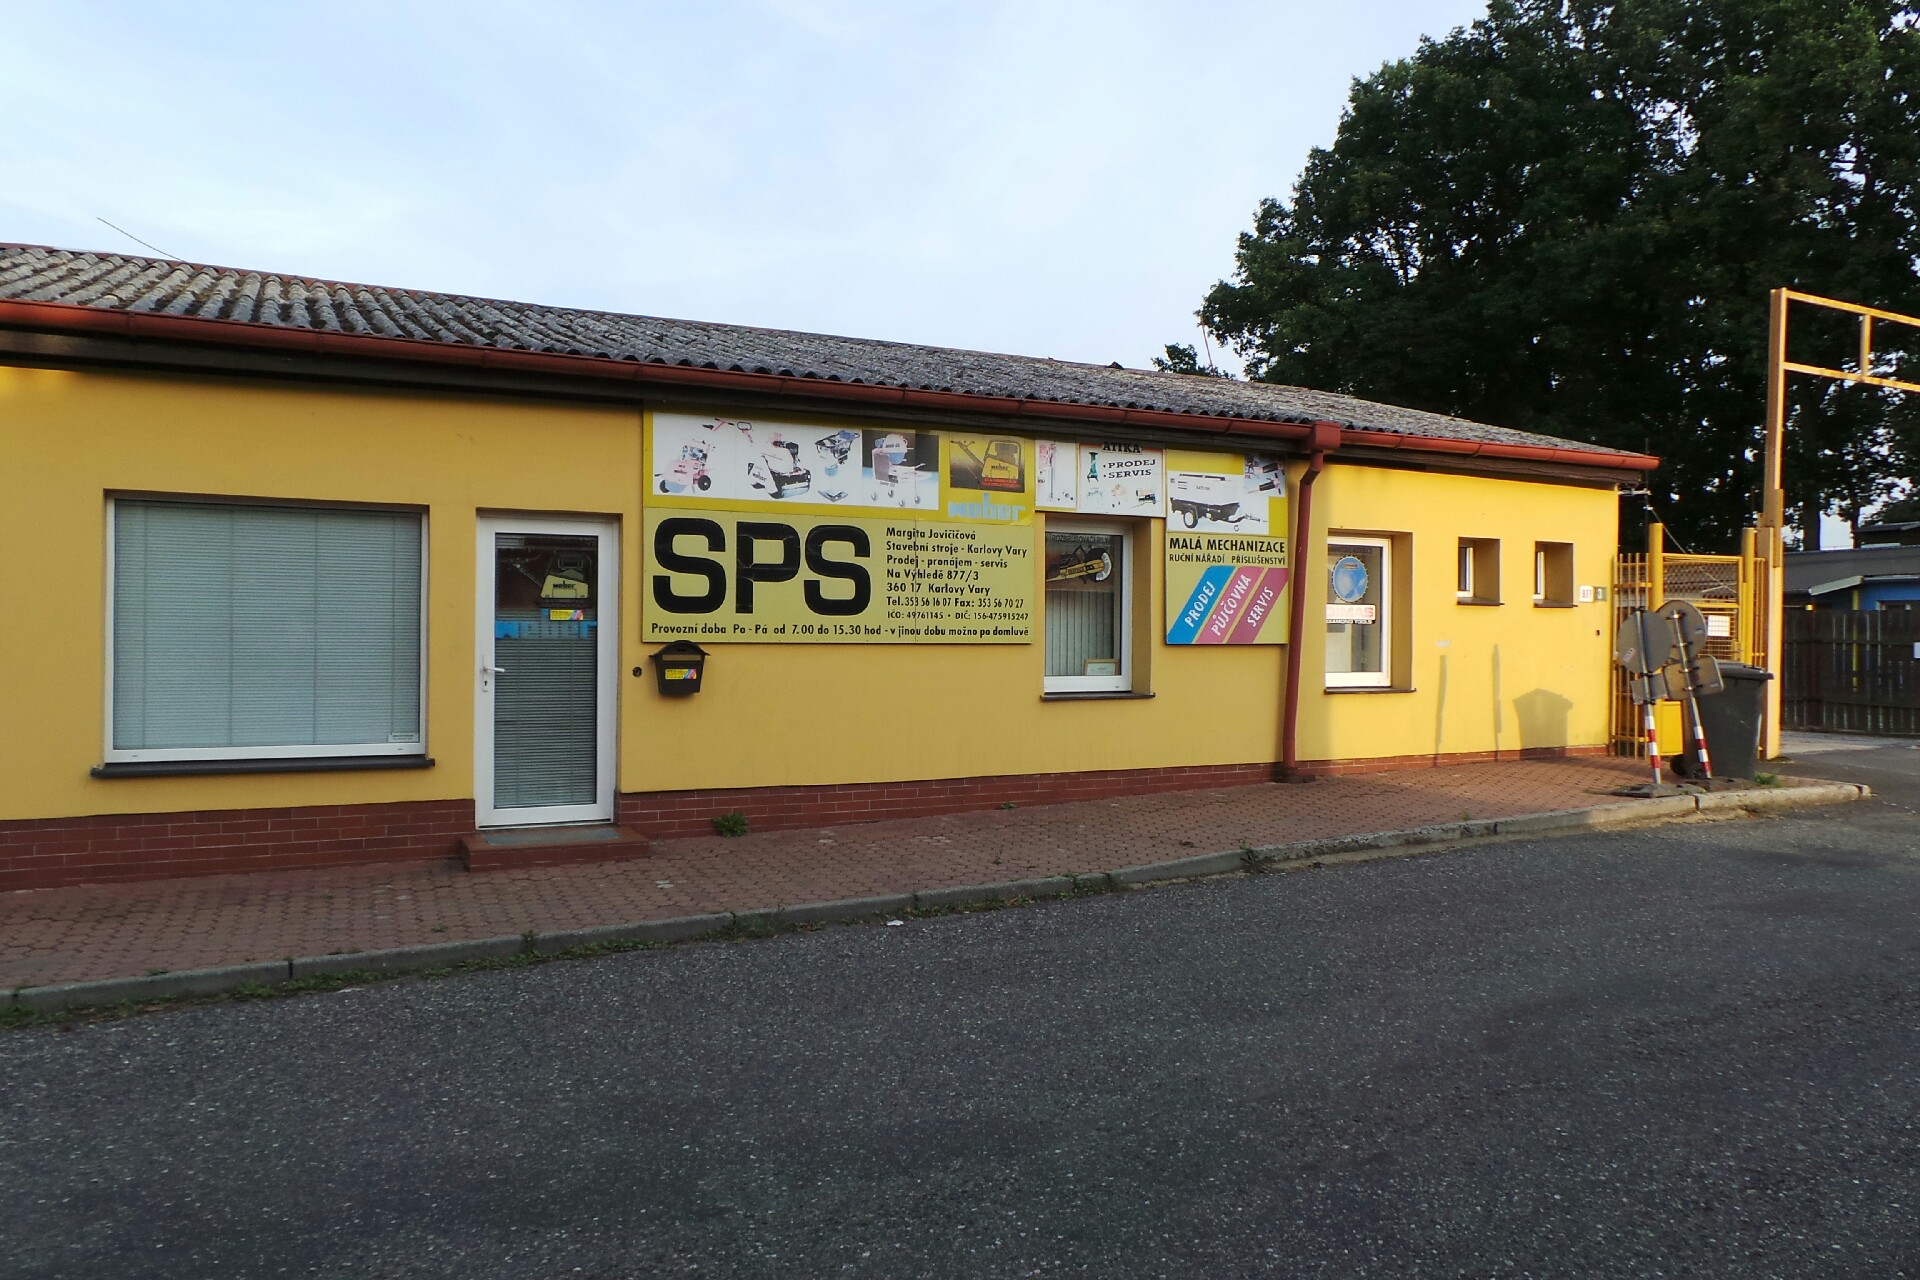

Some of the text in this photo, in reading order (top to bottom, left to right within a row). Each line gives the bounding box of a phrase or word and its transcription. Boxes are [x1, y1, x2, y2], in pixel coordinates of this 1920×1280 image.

[1103, 441, 1141, 453] ATIKA
[1108, 459, 1156, 468] PRODEJ
[1108, 469, 1152, 479] SERVIS
[948, 493, 1025, 521] weber
[886, 527, 976, 540] Margita Jovičičová
[886, 541, 929, 552] Stavební
[932, 544, 959, 555] stroje
[967, 544, 1003, 557] Karlovy
[1005, 545, 1027, 558] Vary
[1169, 536, 1285, 553] MALÁ MECHANIZACE
[887, 555, 918, 568] Prodej
[927, 556, 972, 569] pronájem
[980, 559, 1008, 568] servis
[1169, 553, 1286, 566] RUČNÍ NÁŘADÍ PŘÍSLUŠENSTVÍ
[653, 517, 871, 616] SPS
[886, 569, 979, 582] Na Výhledě 877/3
[886, 583, 990, 596] 360 17 Karlovy Vary
[921, 597, 930, 607] 56
[933, 597, 940, 607] 16
[942, 598, 951, 607] 07
[954, 598, 975, 607] Fax:
[977, 598, 991, 608] 353
[993, 599, 1002, 608] 56
[1004, 599, 1013, 608] 70
[1015, 599, 1024, 608] 27
[1184, 580, 1216, 628] PRODEJ
[1211, 574, 1252, 636] PŮJČOVNA
[1247, 586, 1274, 628] SERVIS
[906, 611, 943, 620] 49761145
[955, 610, 971, 620] DIČ:
[973, 612, 1029, 620] 156-475915247
[651, 622, 698, 634] Provozní
[701, 623, 727, 634] doba
[754, 624, 767, 634] Pá
[773, 624, 786, 634] od
[791, 625, 814, 635] 7.00
[817, 624, 829, 635] do
[833, 625, 861, 635] 15.30
[864, 625, 881, 635] hod
[898, 625, 921, 638] jinou
[924, 625, 946, 636] dobu
[949, 626, 978, 636] možno
[980, 629, 991, 638] po
[993, 626, 1029, 636] domluvě
